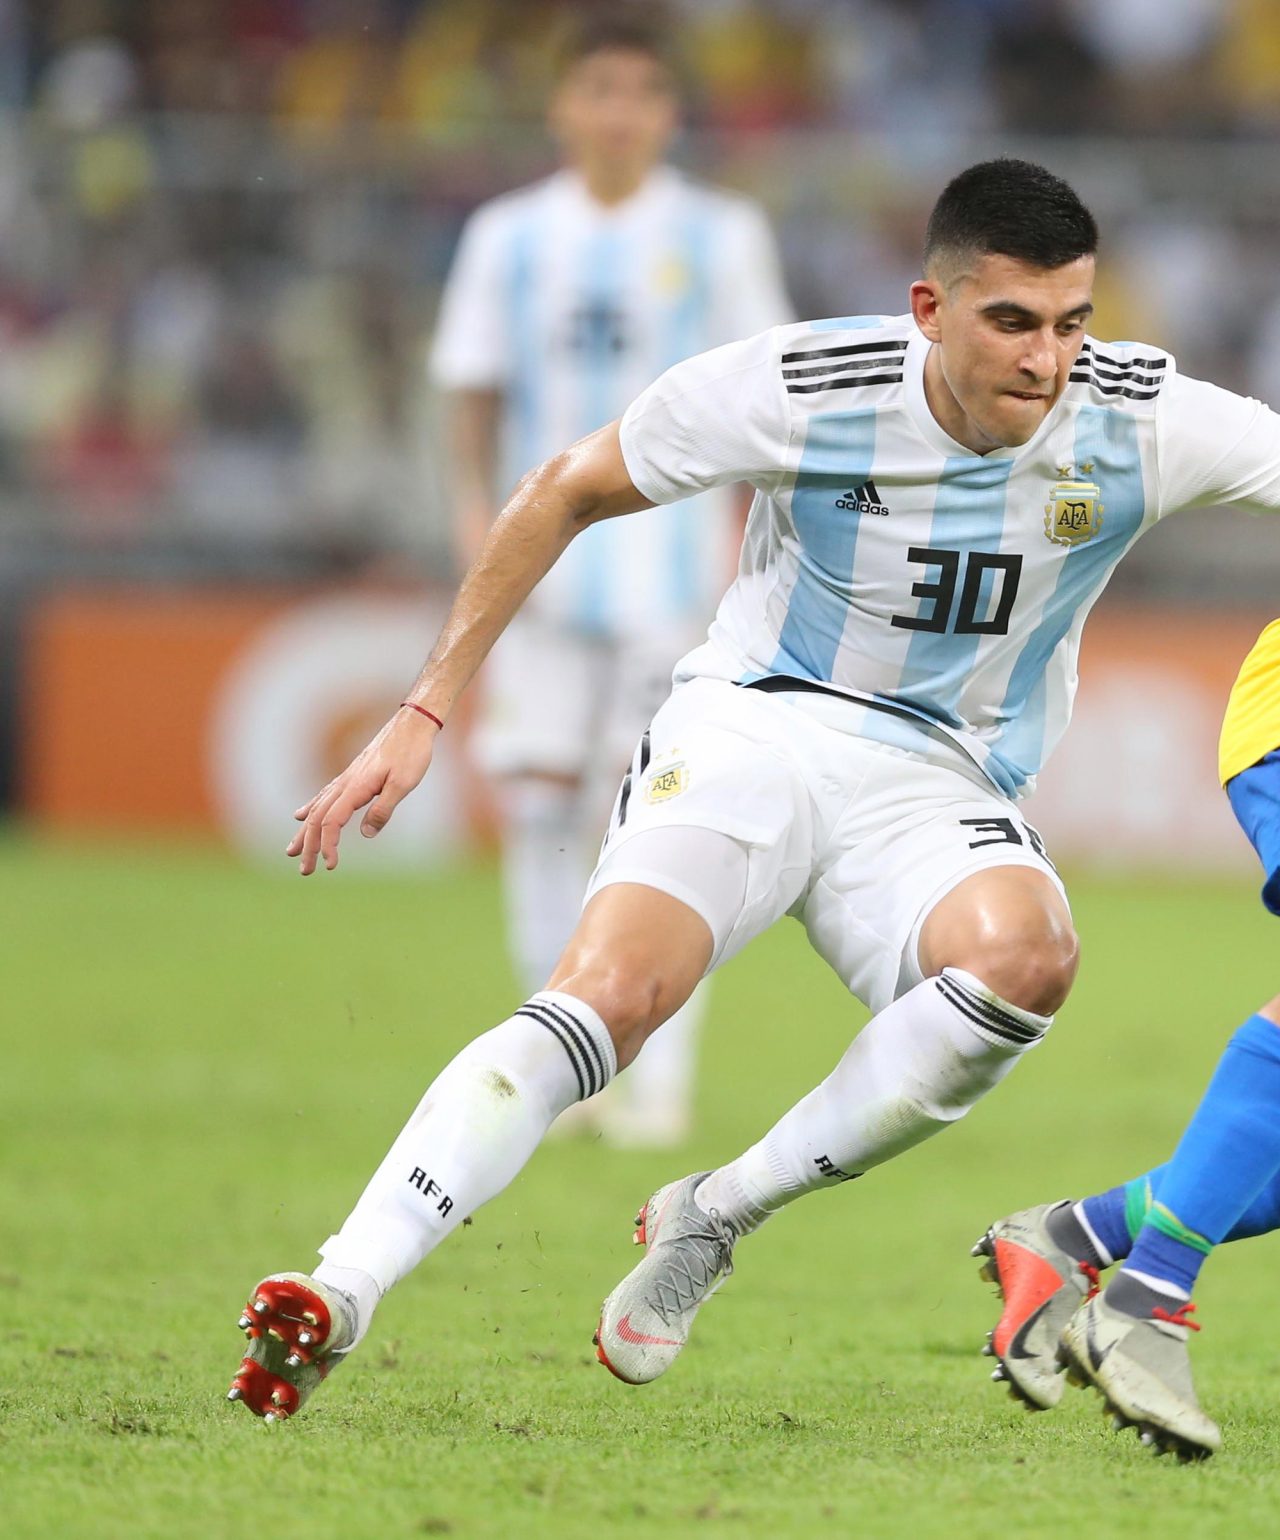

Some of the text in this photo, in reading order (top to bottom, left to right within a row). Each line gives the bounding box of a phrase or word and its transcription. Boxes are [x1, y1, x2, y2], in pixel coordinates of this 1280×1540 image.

[835, 499, 889, 516] adidas
[1057, 501, 1089, 530] AFA
[891, 547, 1023, 635] 30
[652, 771, 678, 791] AFA
[408, 1166, 453, 1218] AFA
